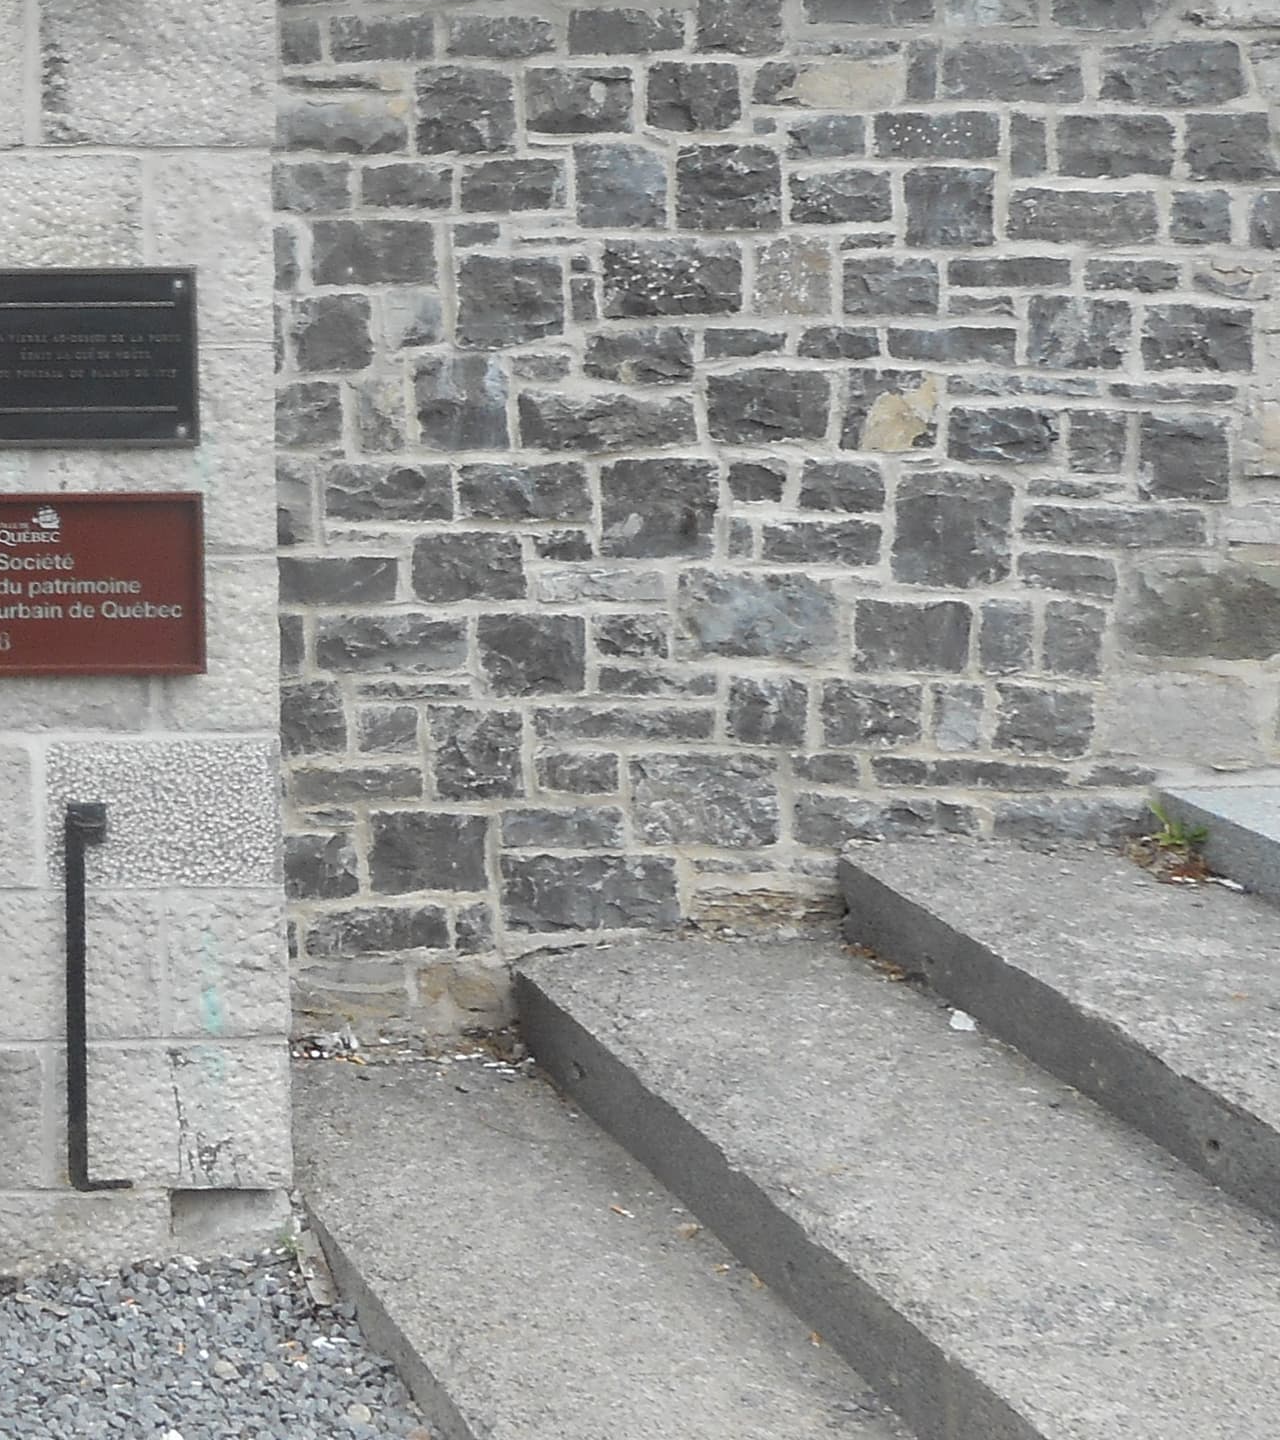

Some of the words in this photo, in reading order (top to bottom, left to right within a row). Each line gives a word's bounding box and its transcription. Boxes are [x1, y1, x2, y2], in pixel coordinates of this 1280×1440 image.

[28, 577, 142, 598] patrimoine
[69, 601, 95, 619] de
[101, 601, 184, 619] Québec
